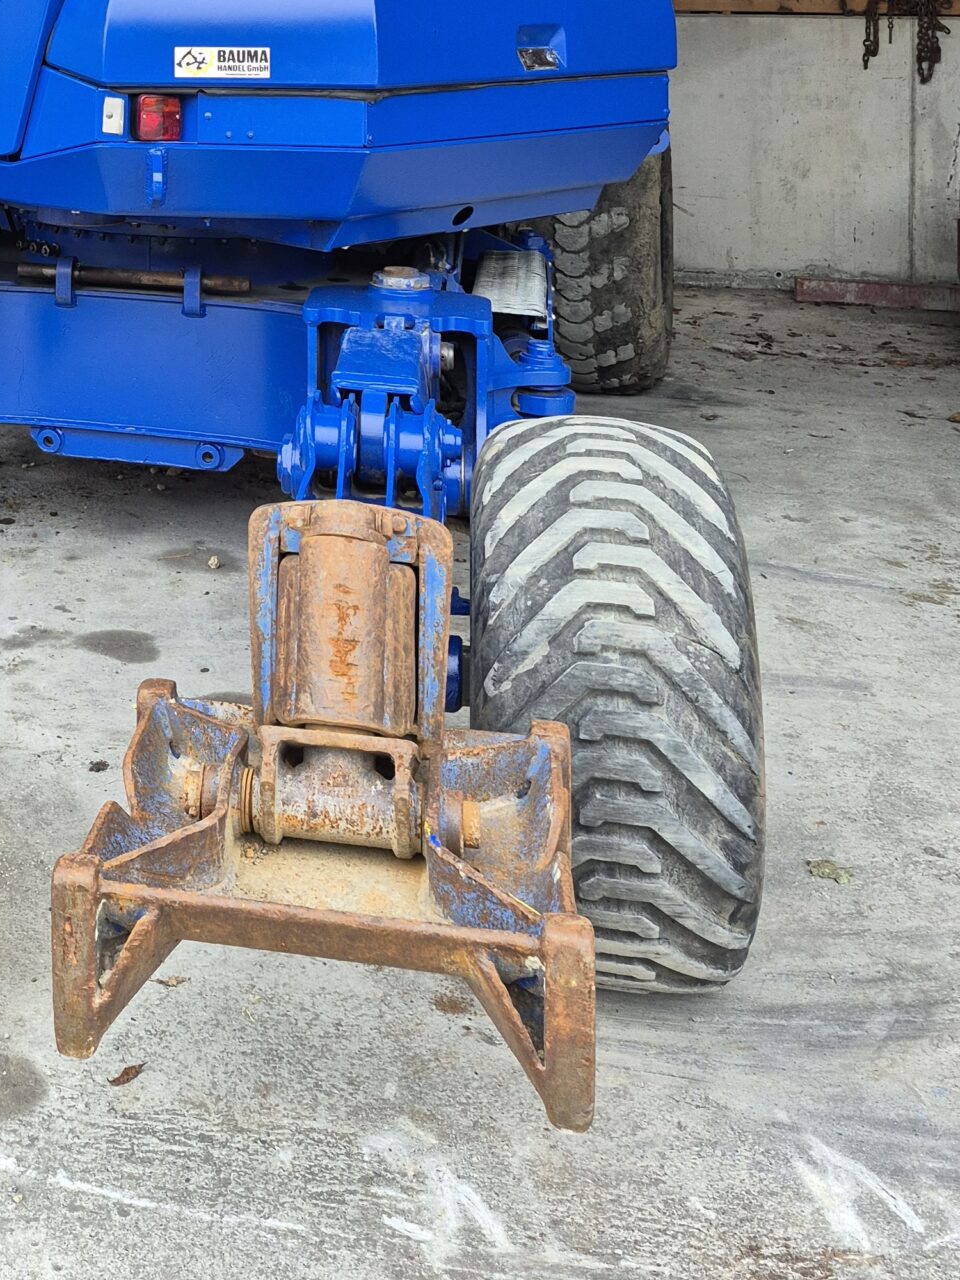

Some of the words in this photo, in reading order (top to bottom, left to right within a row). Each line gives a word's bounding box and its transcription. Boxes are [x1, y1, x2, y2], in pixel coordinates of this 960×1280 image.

[217, 49, 269, 64] BAUMA
[217, 64, 246, 72] HANDEL
[246, 64, 269, 73] GmbH
